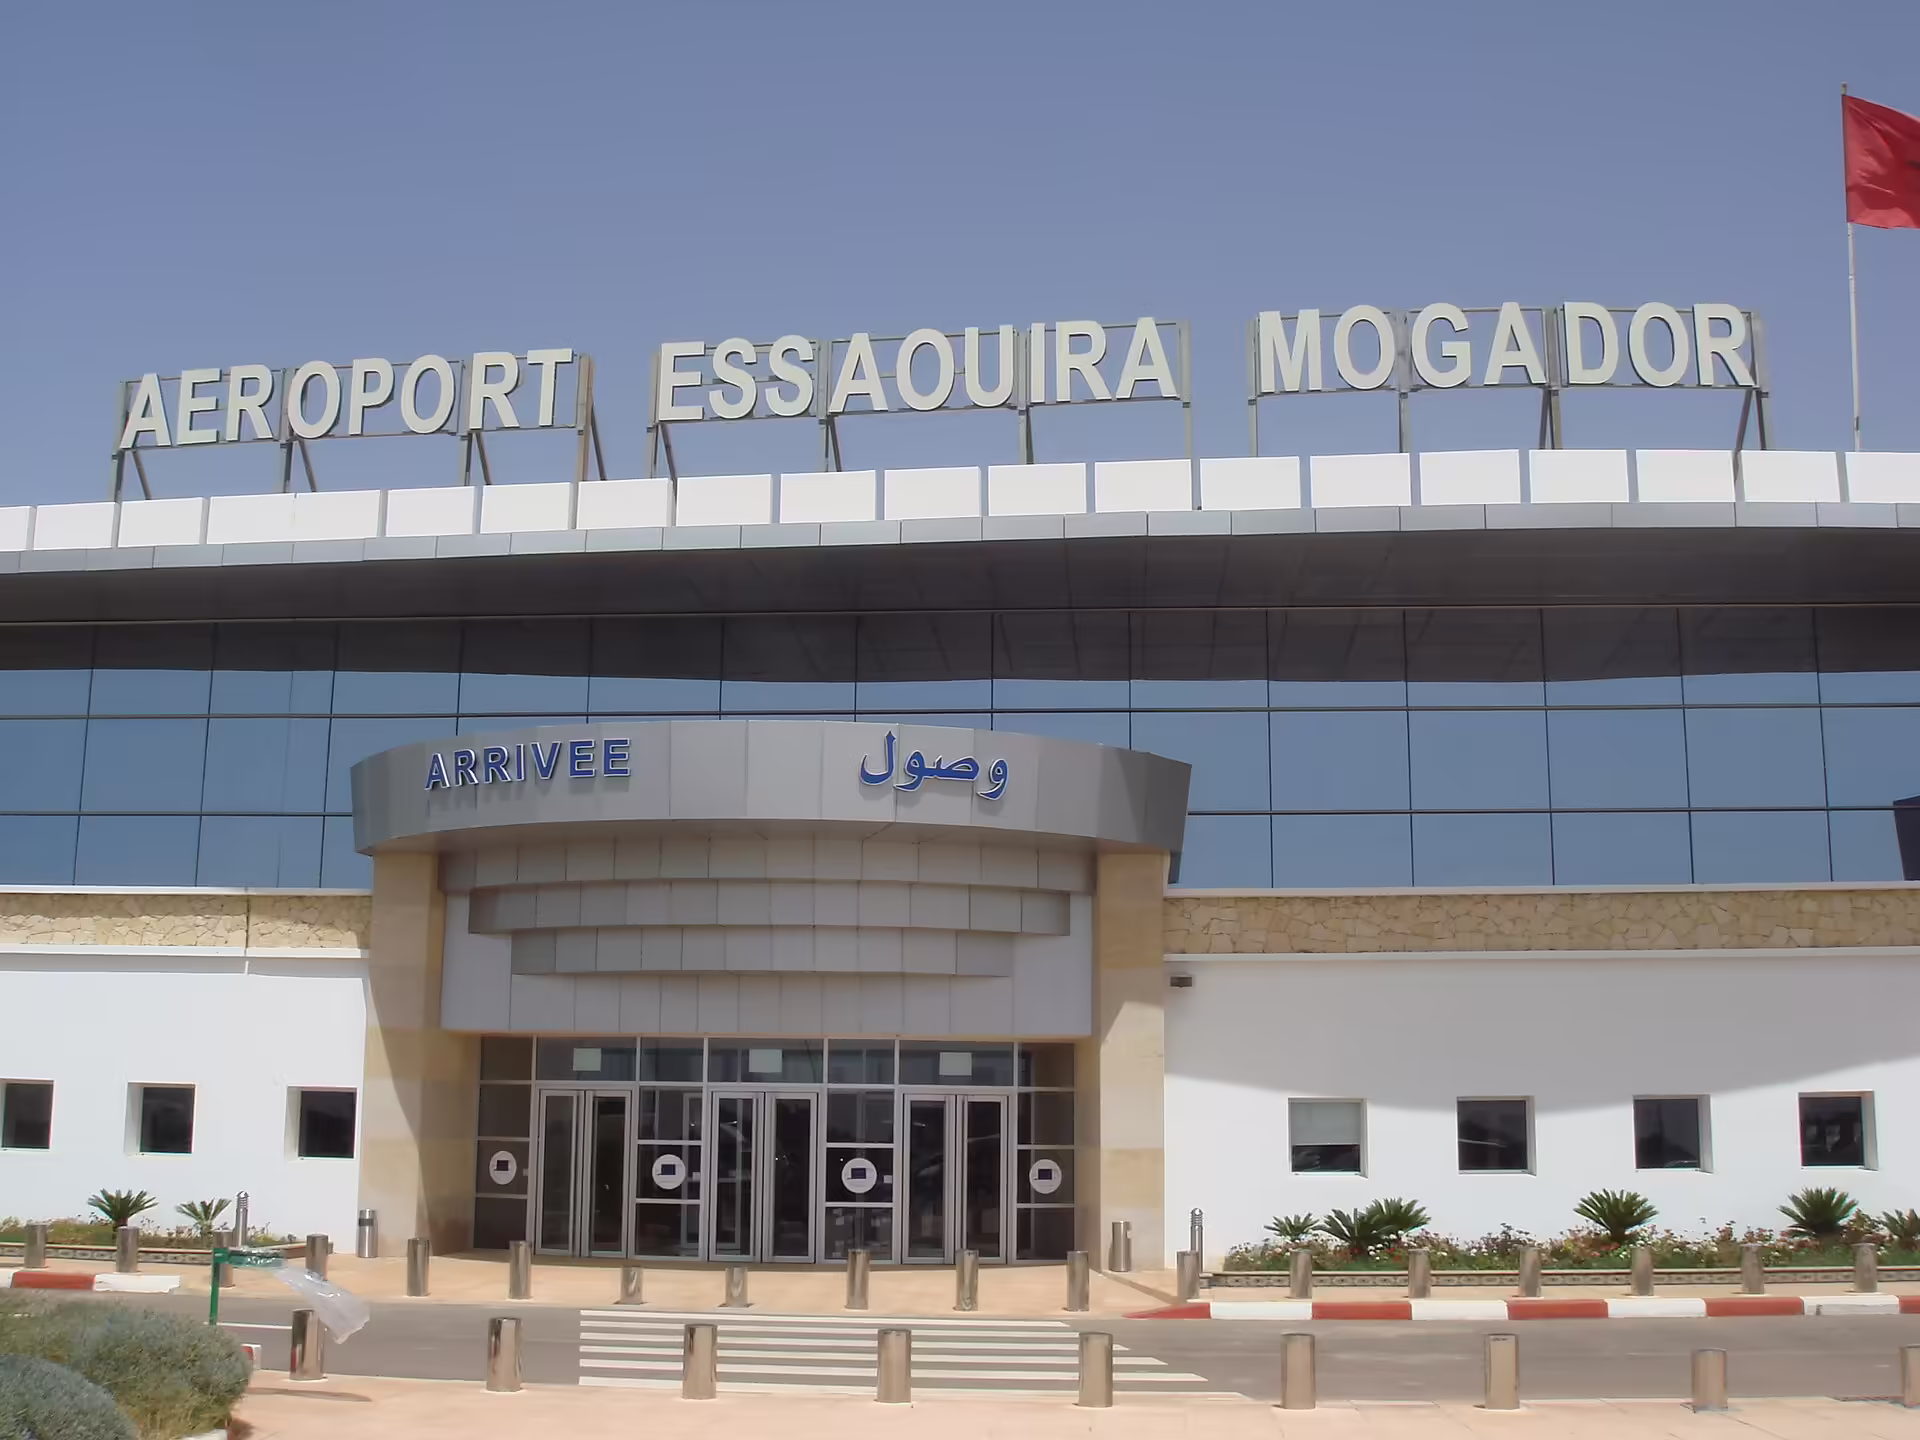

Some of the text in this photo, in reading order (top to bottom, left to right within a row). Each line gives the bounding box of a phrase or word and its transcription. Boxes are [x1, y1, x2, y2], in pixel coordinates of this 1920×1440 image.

[120, 301, 1755, 449] AEROPORT ESSAOUIRA MOGADOR
[424, 738, 631, 790] ARRIVEE
[859, 730, 1009, 800] وصول
